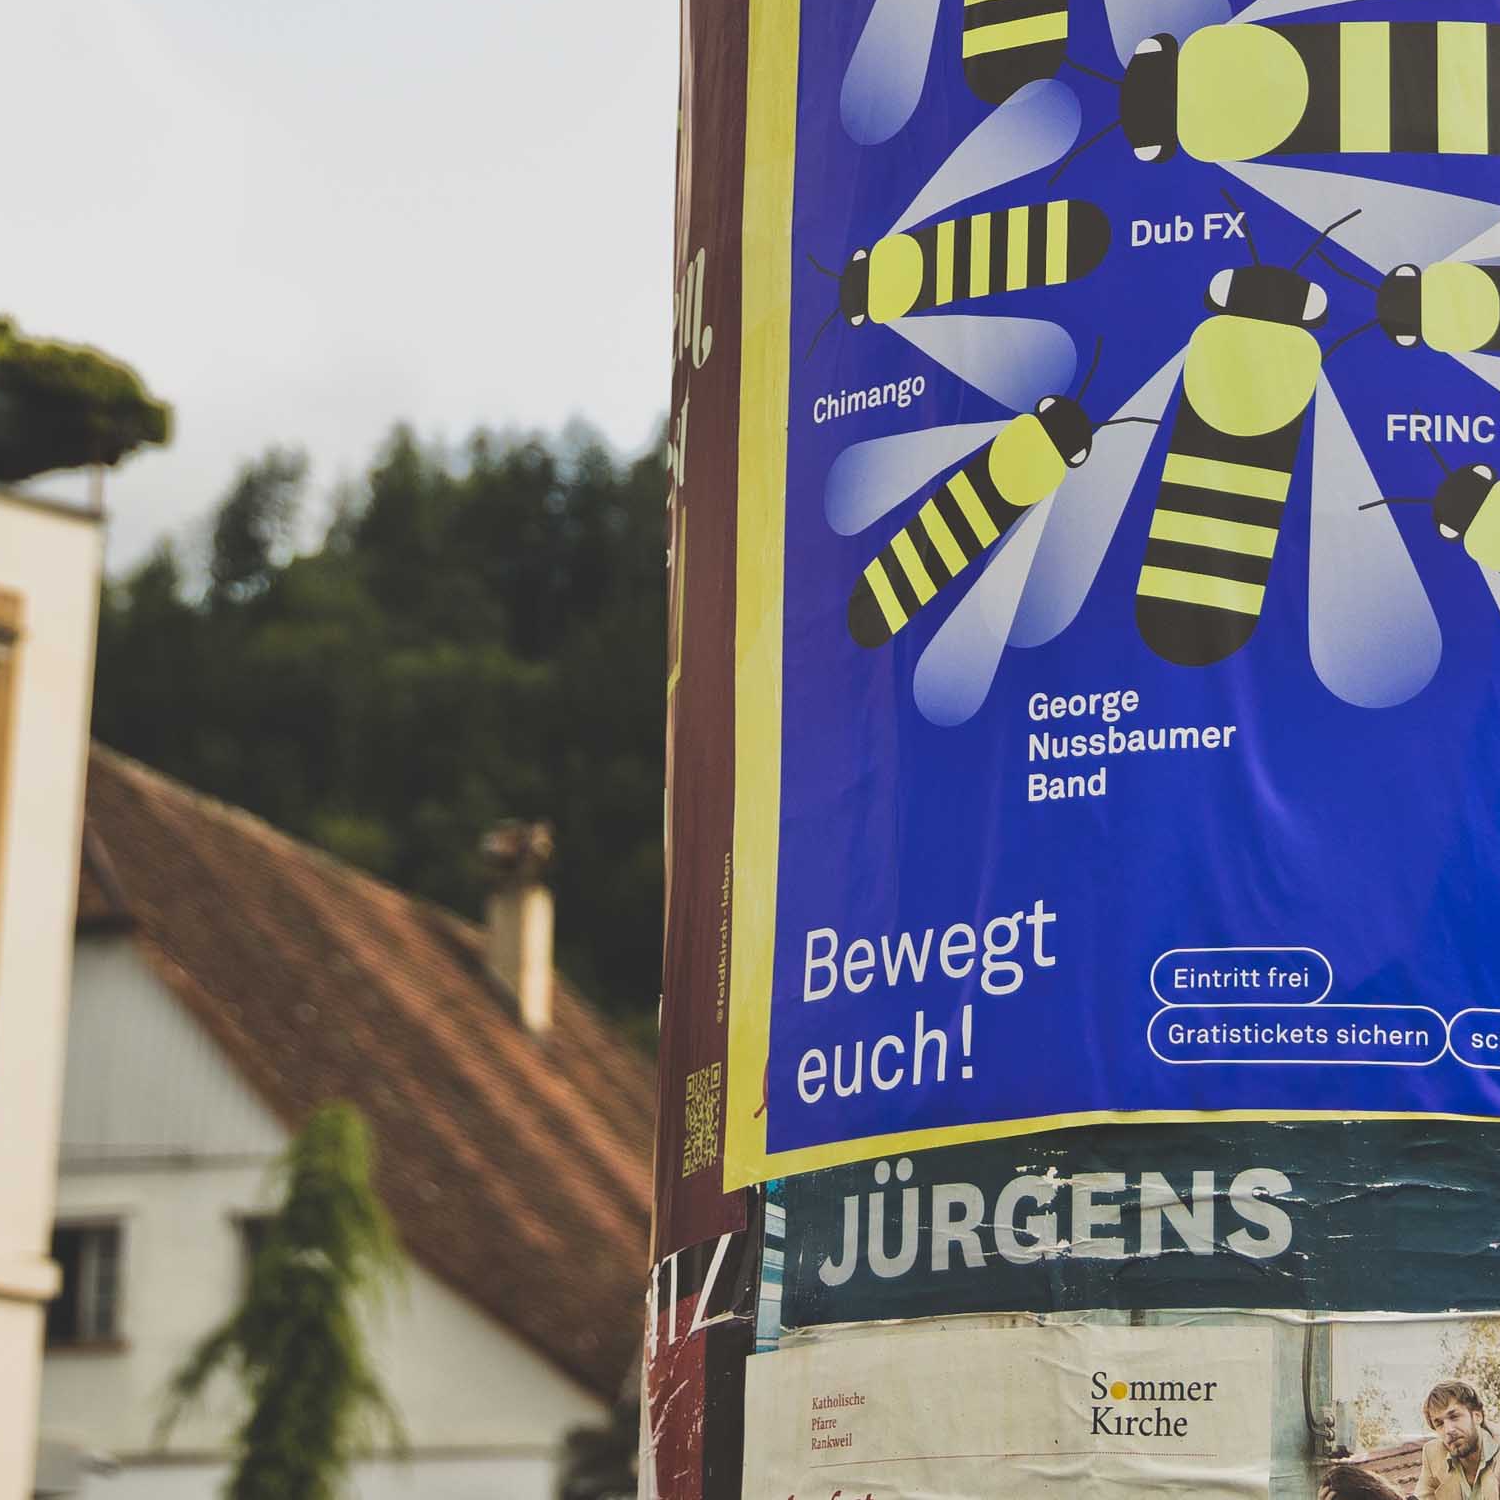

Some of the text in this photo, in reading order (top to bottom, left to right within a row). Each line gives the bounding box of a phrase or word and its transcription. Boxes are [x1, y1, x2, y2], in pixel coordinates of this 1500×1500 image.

[1131, 211, 1246, 247] Dub FX
[813, 372, 926, 424] Chimango
[1386, 414, 1497, 445] FRINC
[1028, 686, 1140, 722] George
[1028, 726, 1237, 762] Nussbaumer
[1027, 767, 1107, 802] Band
[803, 899, 1057, 1003] Bewegt
[1173, 966, 1310, 989] Eintritt frei
[1168, 1023, 1430, 1048] Gratistickets sichern
[797, 1004, 974, 1104] euch!
[818, 1156, 1293, 1287] JÜRGENS
[811, 1391, 867, 1411] Katholische
[1091, 1371, 1218, 1402] Sommer
[811, 1416, 837, 1432] Pfarre
[1090, 1406, 1189, 1438] Kirche
[811, 1432, 853, 1451] Rankweil
